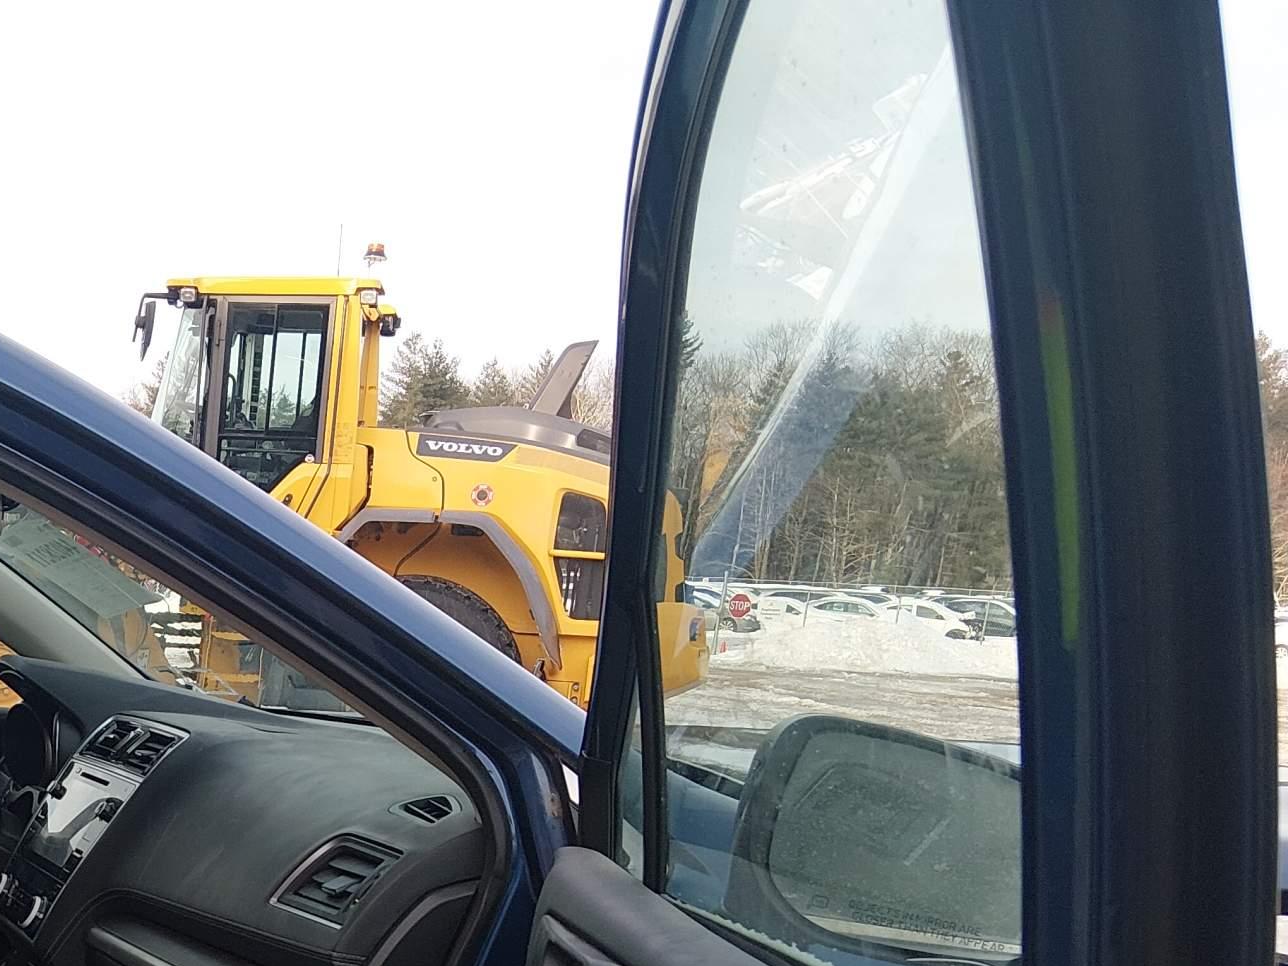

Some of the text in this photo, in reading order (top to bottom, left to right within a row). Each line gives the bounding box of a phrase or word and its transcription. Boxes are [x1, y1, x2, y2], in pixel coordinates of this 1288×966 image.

[425, 440, 503, 456] VOLVO
[730, 600, 750, 611] STOP
[848, 899, 900, 920] OBJECTS
[914, 912, 957, 932] MIRROR
[957, 923, 982, 937] ARE
[851, 911, 894, 929] CLOSER
[928, 926, 956, 943] THEY
[958, 936, 1006, 952] APPEAR
